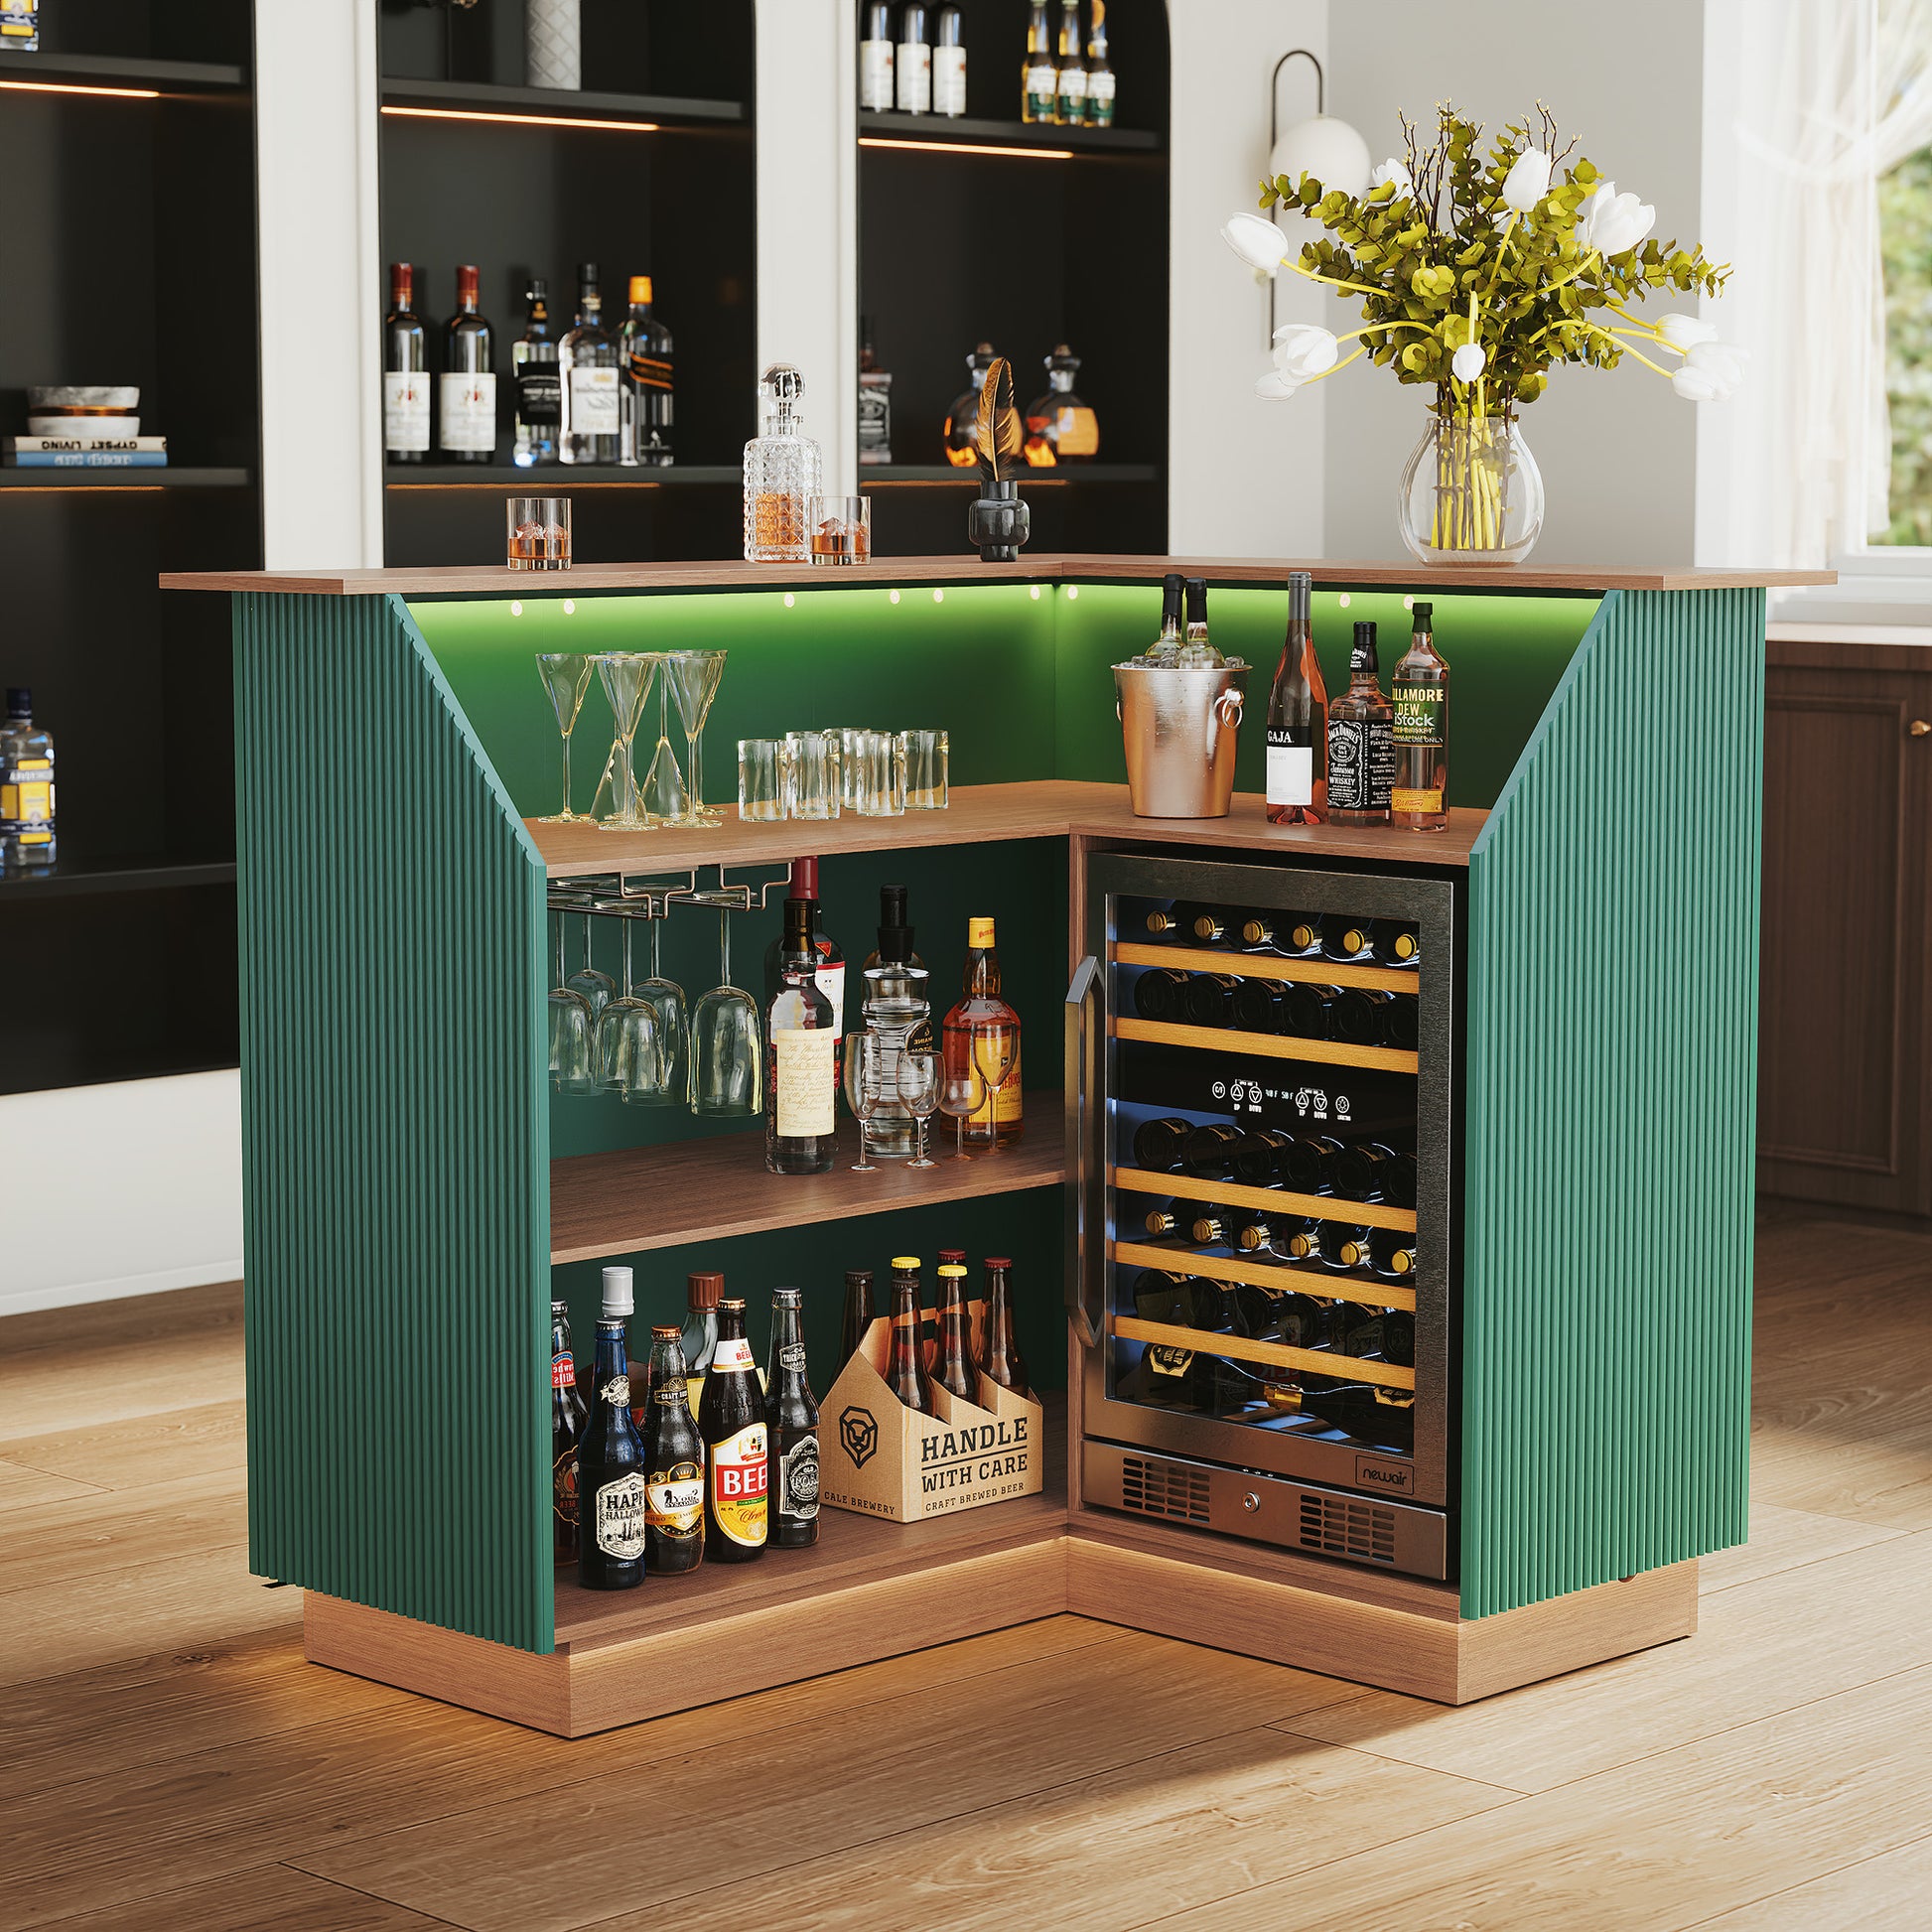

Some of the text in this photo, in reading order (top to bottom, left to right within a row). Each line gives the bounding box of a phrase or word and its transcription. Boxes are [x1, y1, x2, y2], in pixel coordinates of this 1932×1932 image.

[42, 441, 81, 450] LIVING
[1394, 712, 1435, 727] iStock
[1398, 703, 1420, 716] DEW
[921, 1417, 1028, 1462] HANDLE
[921, 1453, 1028, 1493] WITH CARE
[1362, 1468, 1407, 1486] newair
[824, 1491, 896, 1515] CALE BREWERY
[925, 1482, 1025, 1512] CRAFT BREWED BEER
